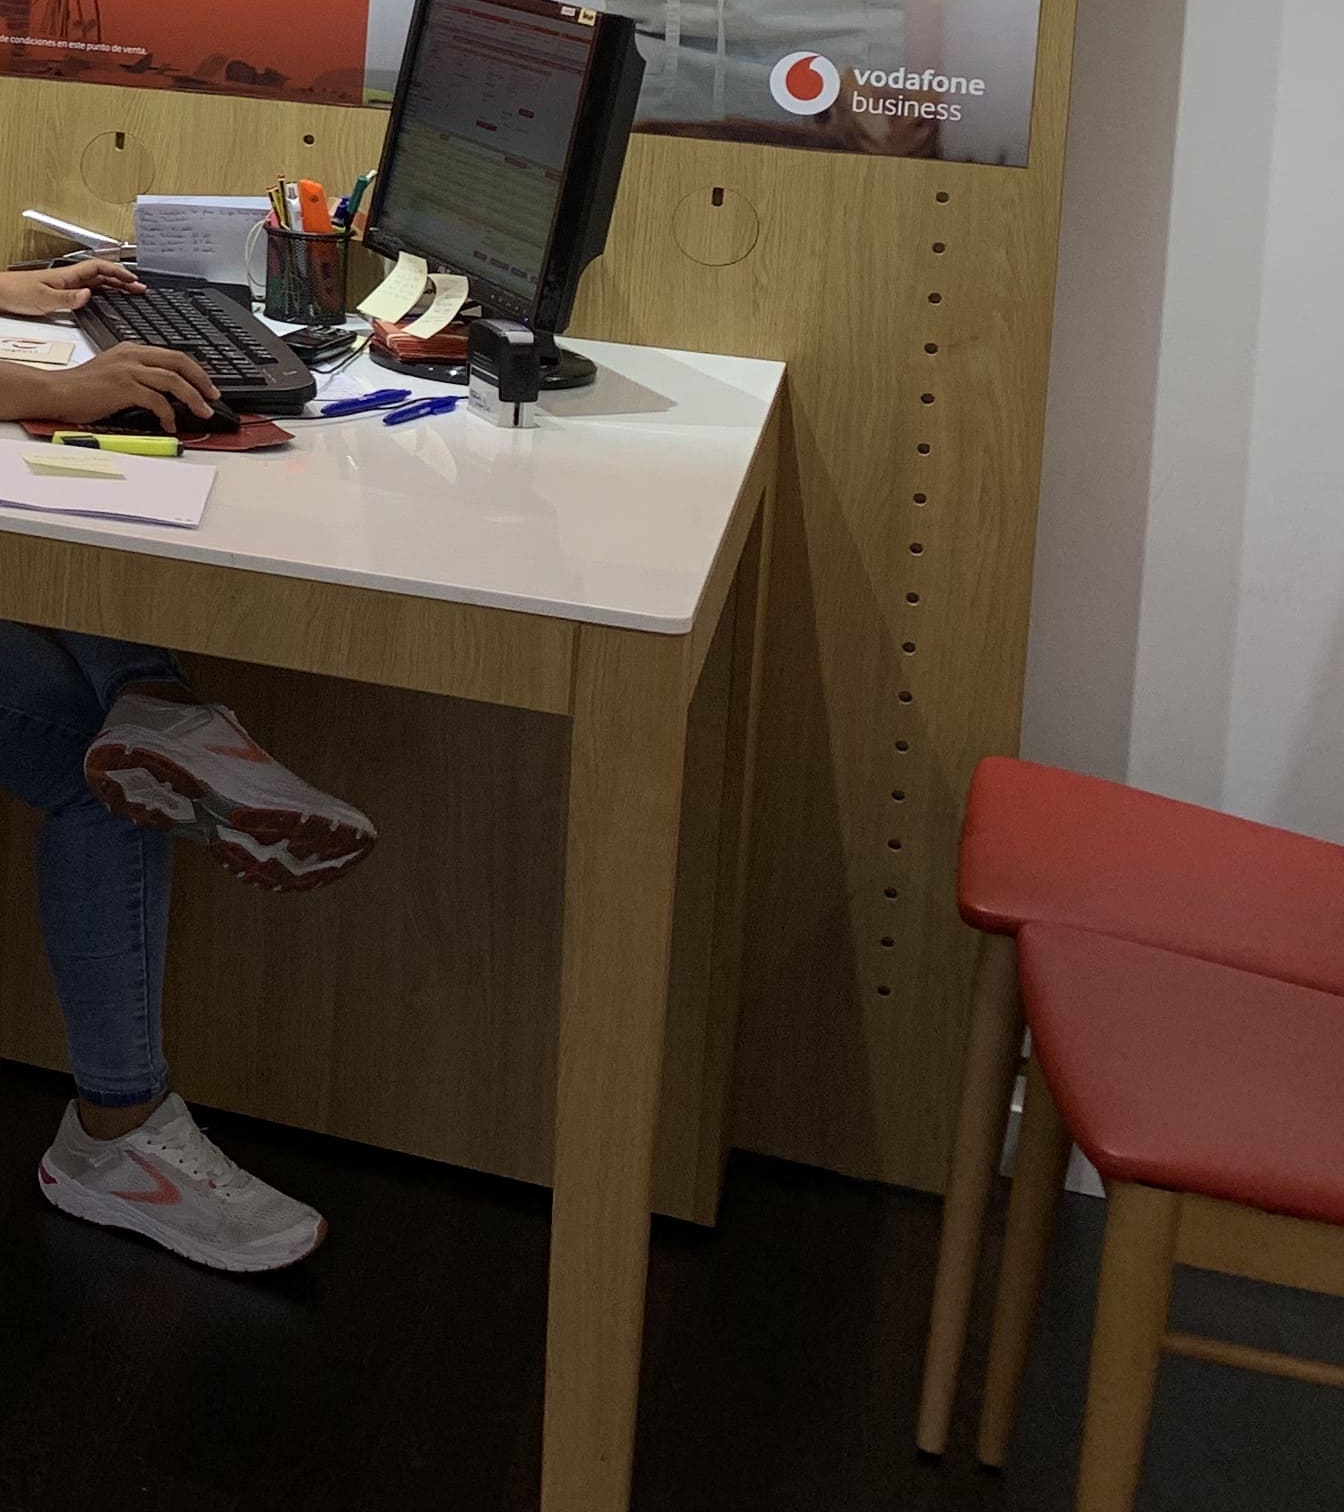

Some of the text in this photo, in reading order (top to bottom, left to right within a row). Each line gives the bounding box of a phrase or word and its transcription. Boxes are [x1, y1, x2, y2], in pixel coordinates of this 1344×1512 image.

[0, 35, 10, 43] de
[10, 37, 56, 46] condiciones
[86, 43, 111, 52] punto
[111, 45, 122, 53] de
[853, 67, 986, 96] vodafone
[851, 91, 962, 121] business
